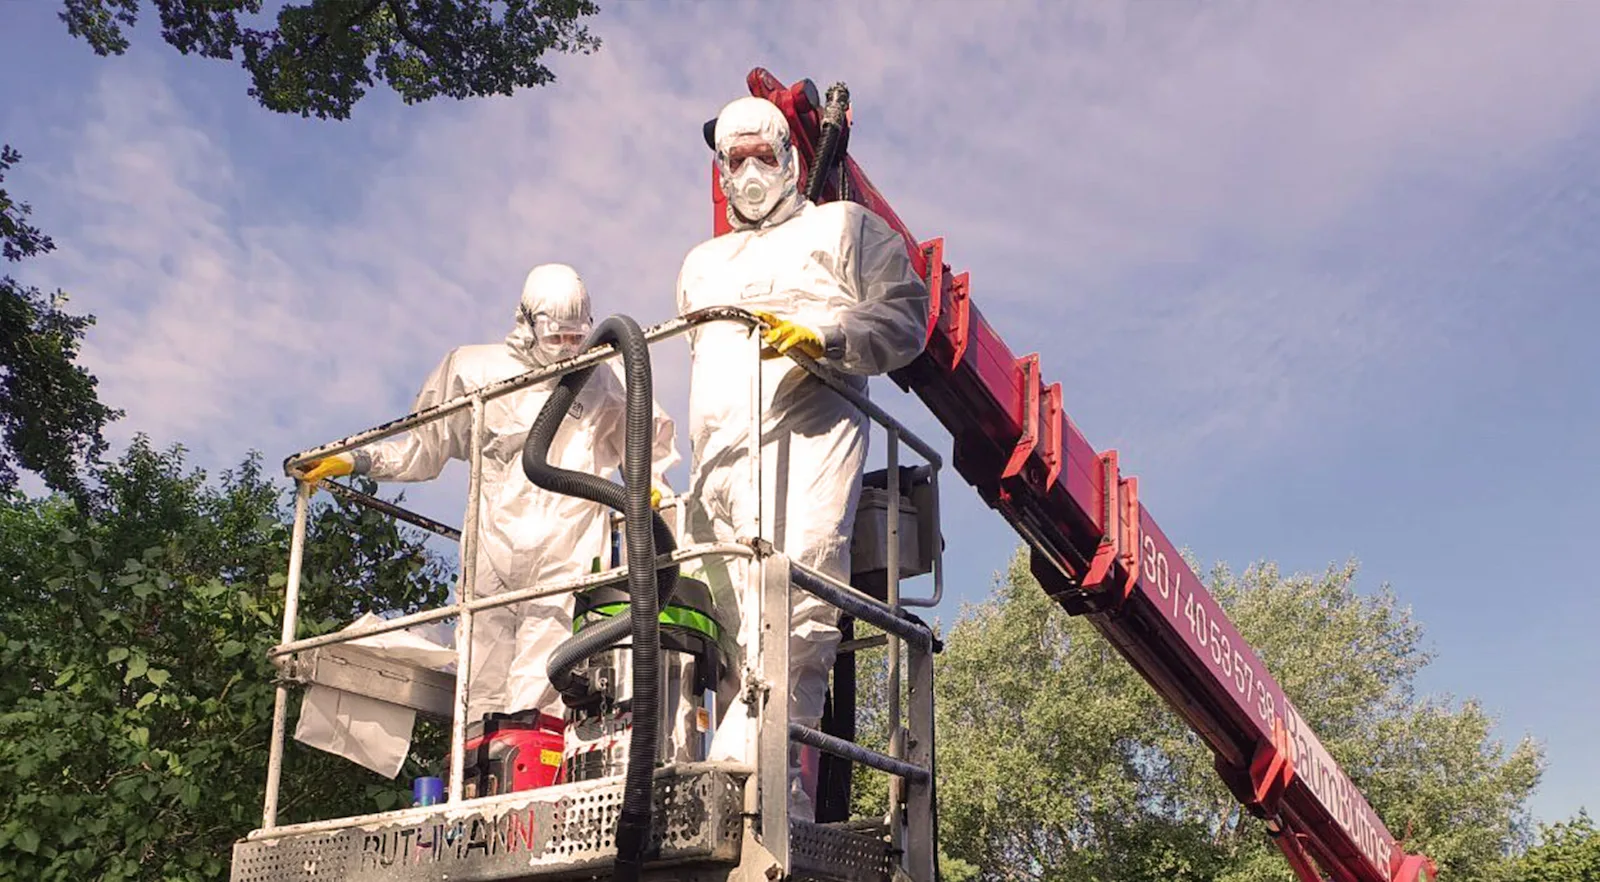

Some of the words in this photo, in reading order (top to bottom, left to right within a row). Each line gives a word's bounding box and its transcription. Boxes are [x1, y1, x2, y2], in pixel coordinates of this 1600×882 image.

[1140, 529, 1169, 600] 30
[1184, 592, 1207, 647] 40
[1210, 619, 1231, 678] 53
[1234, 650, 1253, 702] 57
[1257, 680, 1275, 731] 38
[360, 810, 534, 872] RUTHMANN
